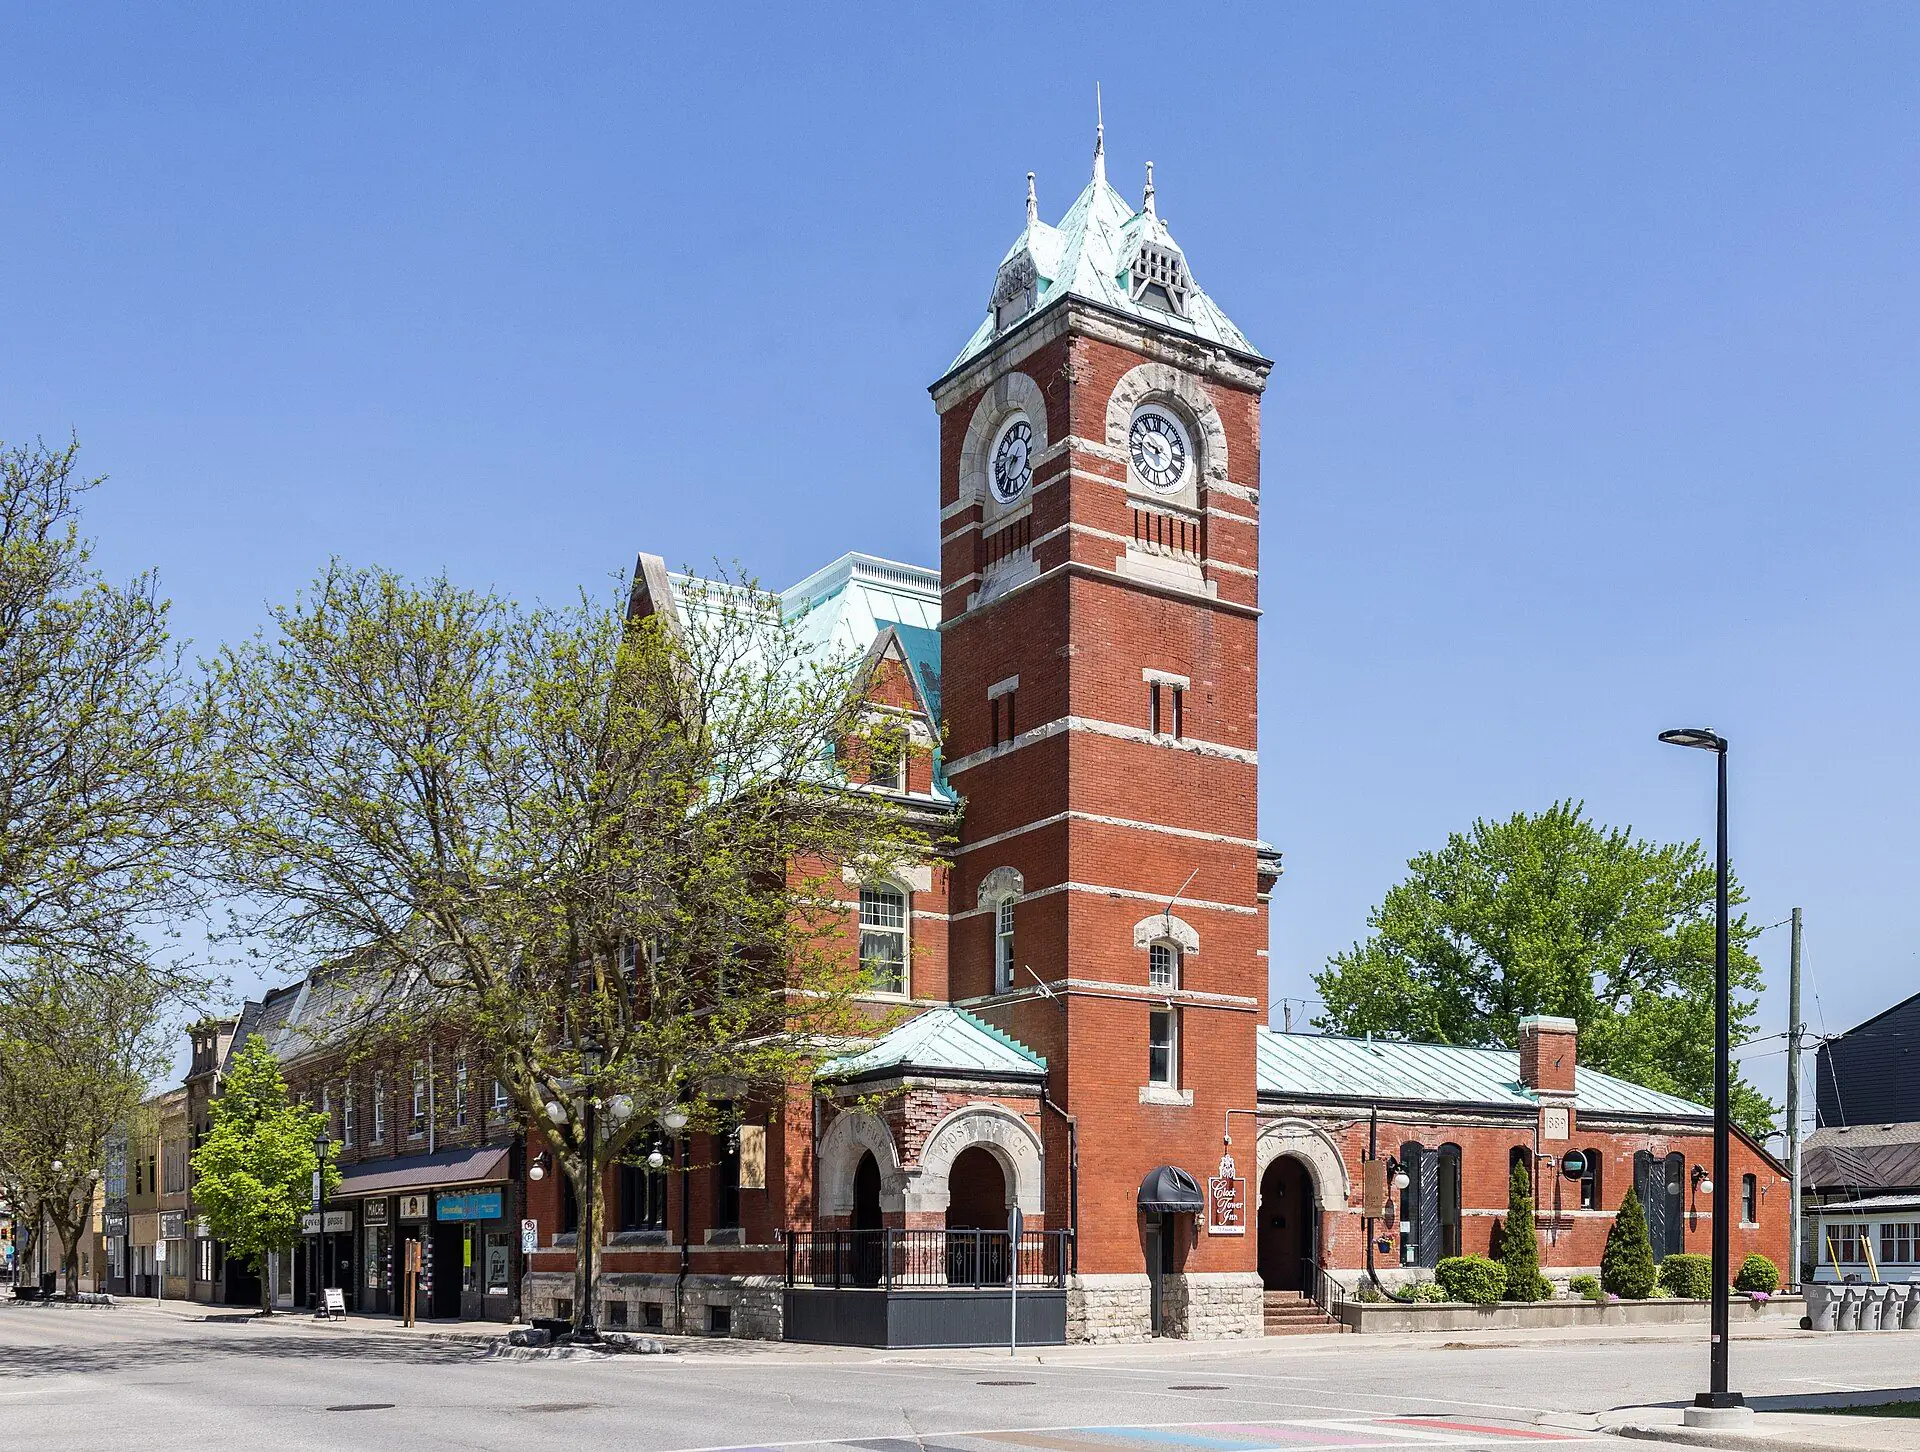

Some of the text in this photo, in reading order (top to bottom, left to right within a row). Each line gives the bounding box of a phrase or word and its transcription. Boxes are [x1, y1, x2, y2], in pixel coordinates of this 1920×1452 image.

[940, 1119, 1028, 1156] POST OFFICE
[1212, 1180, 1236, 1198] Clock
[1217, 1197, 1243, 1213] Tower
[1219, 1209, 1238, 1225] Inn
